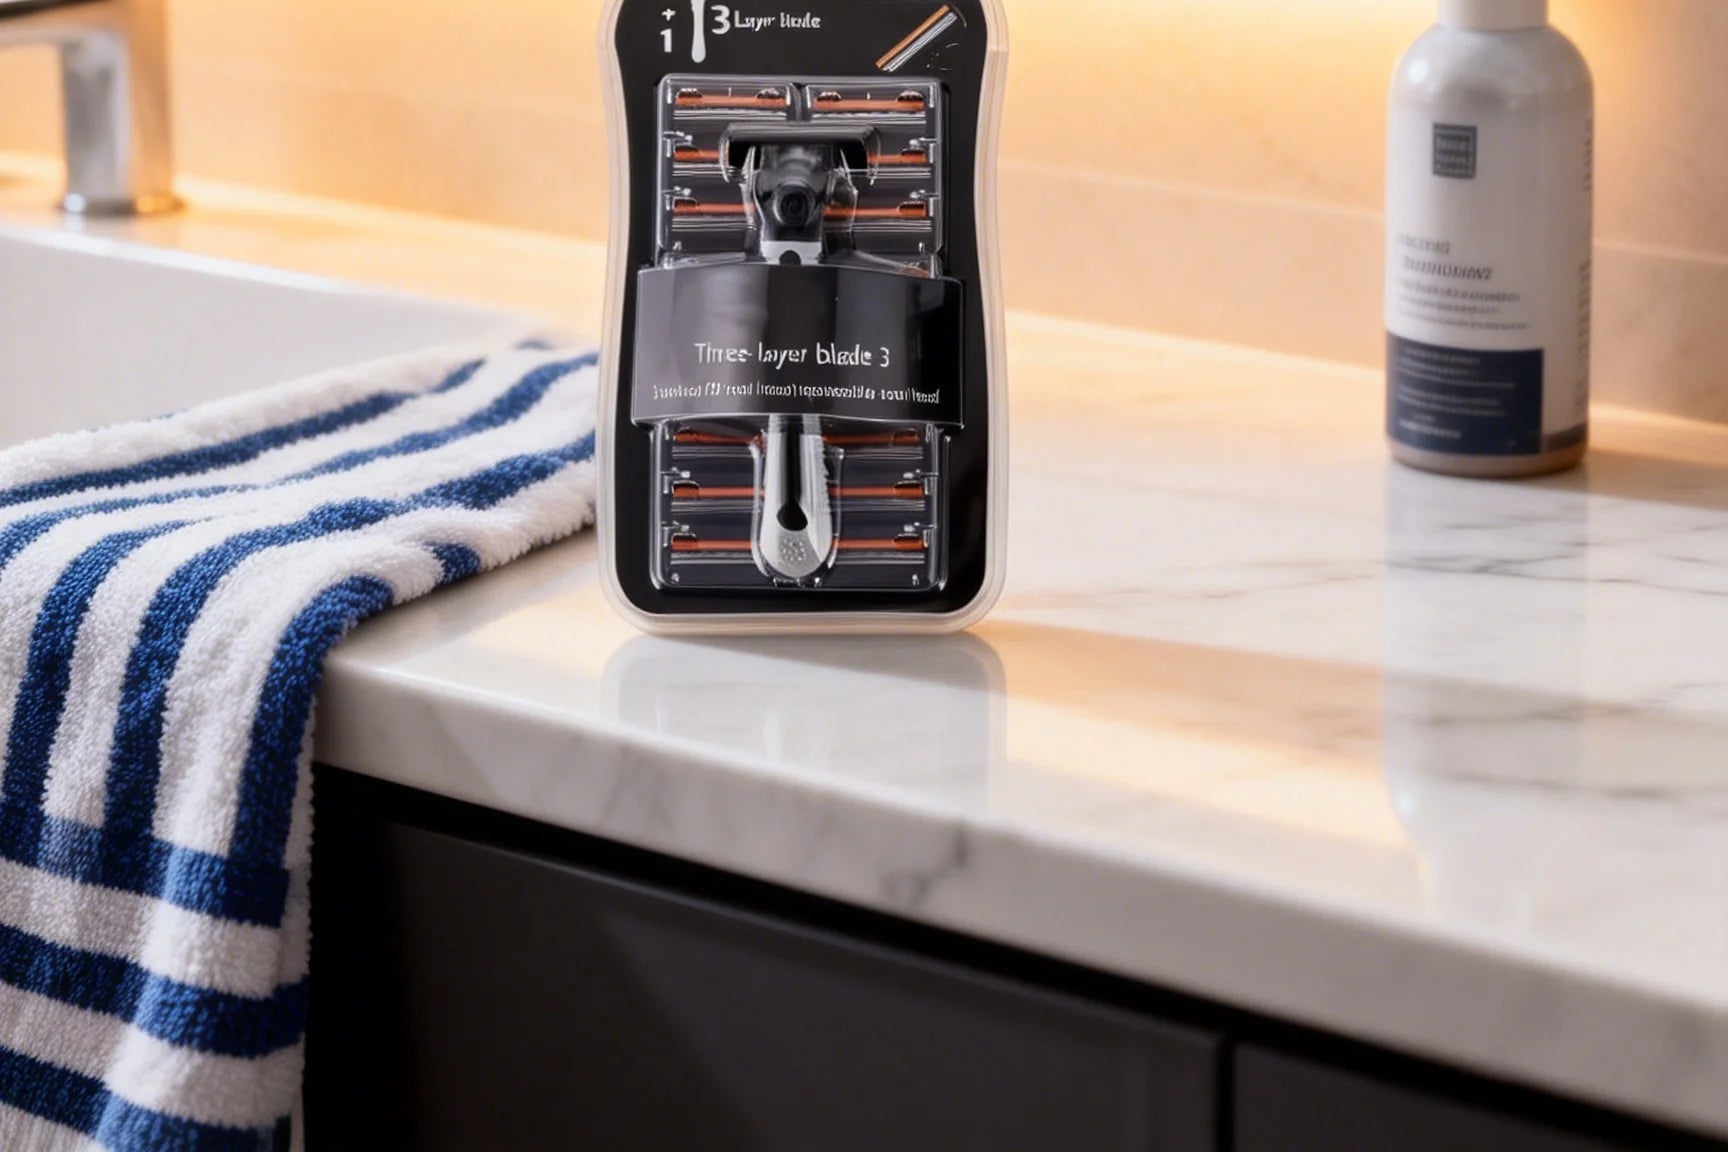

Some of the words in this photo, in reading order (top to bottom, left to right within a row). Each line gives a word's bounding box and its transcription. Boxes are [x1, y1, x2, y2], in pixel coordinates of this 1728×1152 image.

[711, 5, 730, 34] 3
[660, 29, 672, 52] 1
[816, 342, 872, 366] blade
[879, 347, 890, 368] 3
